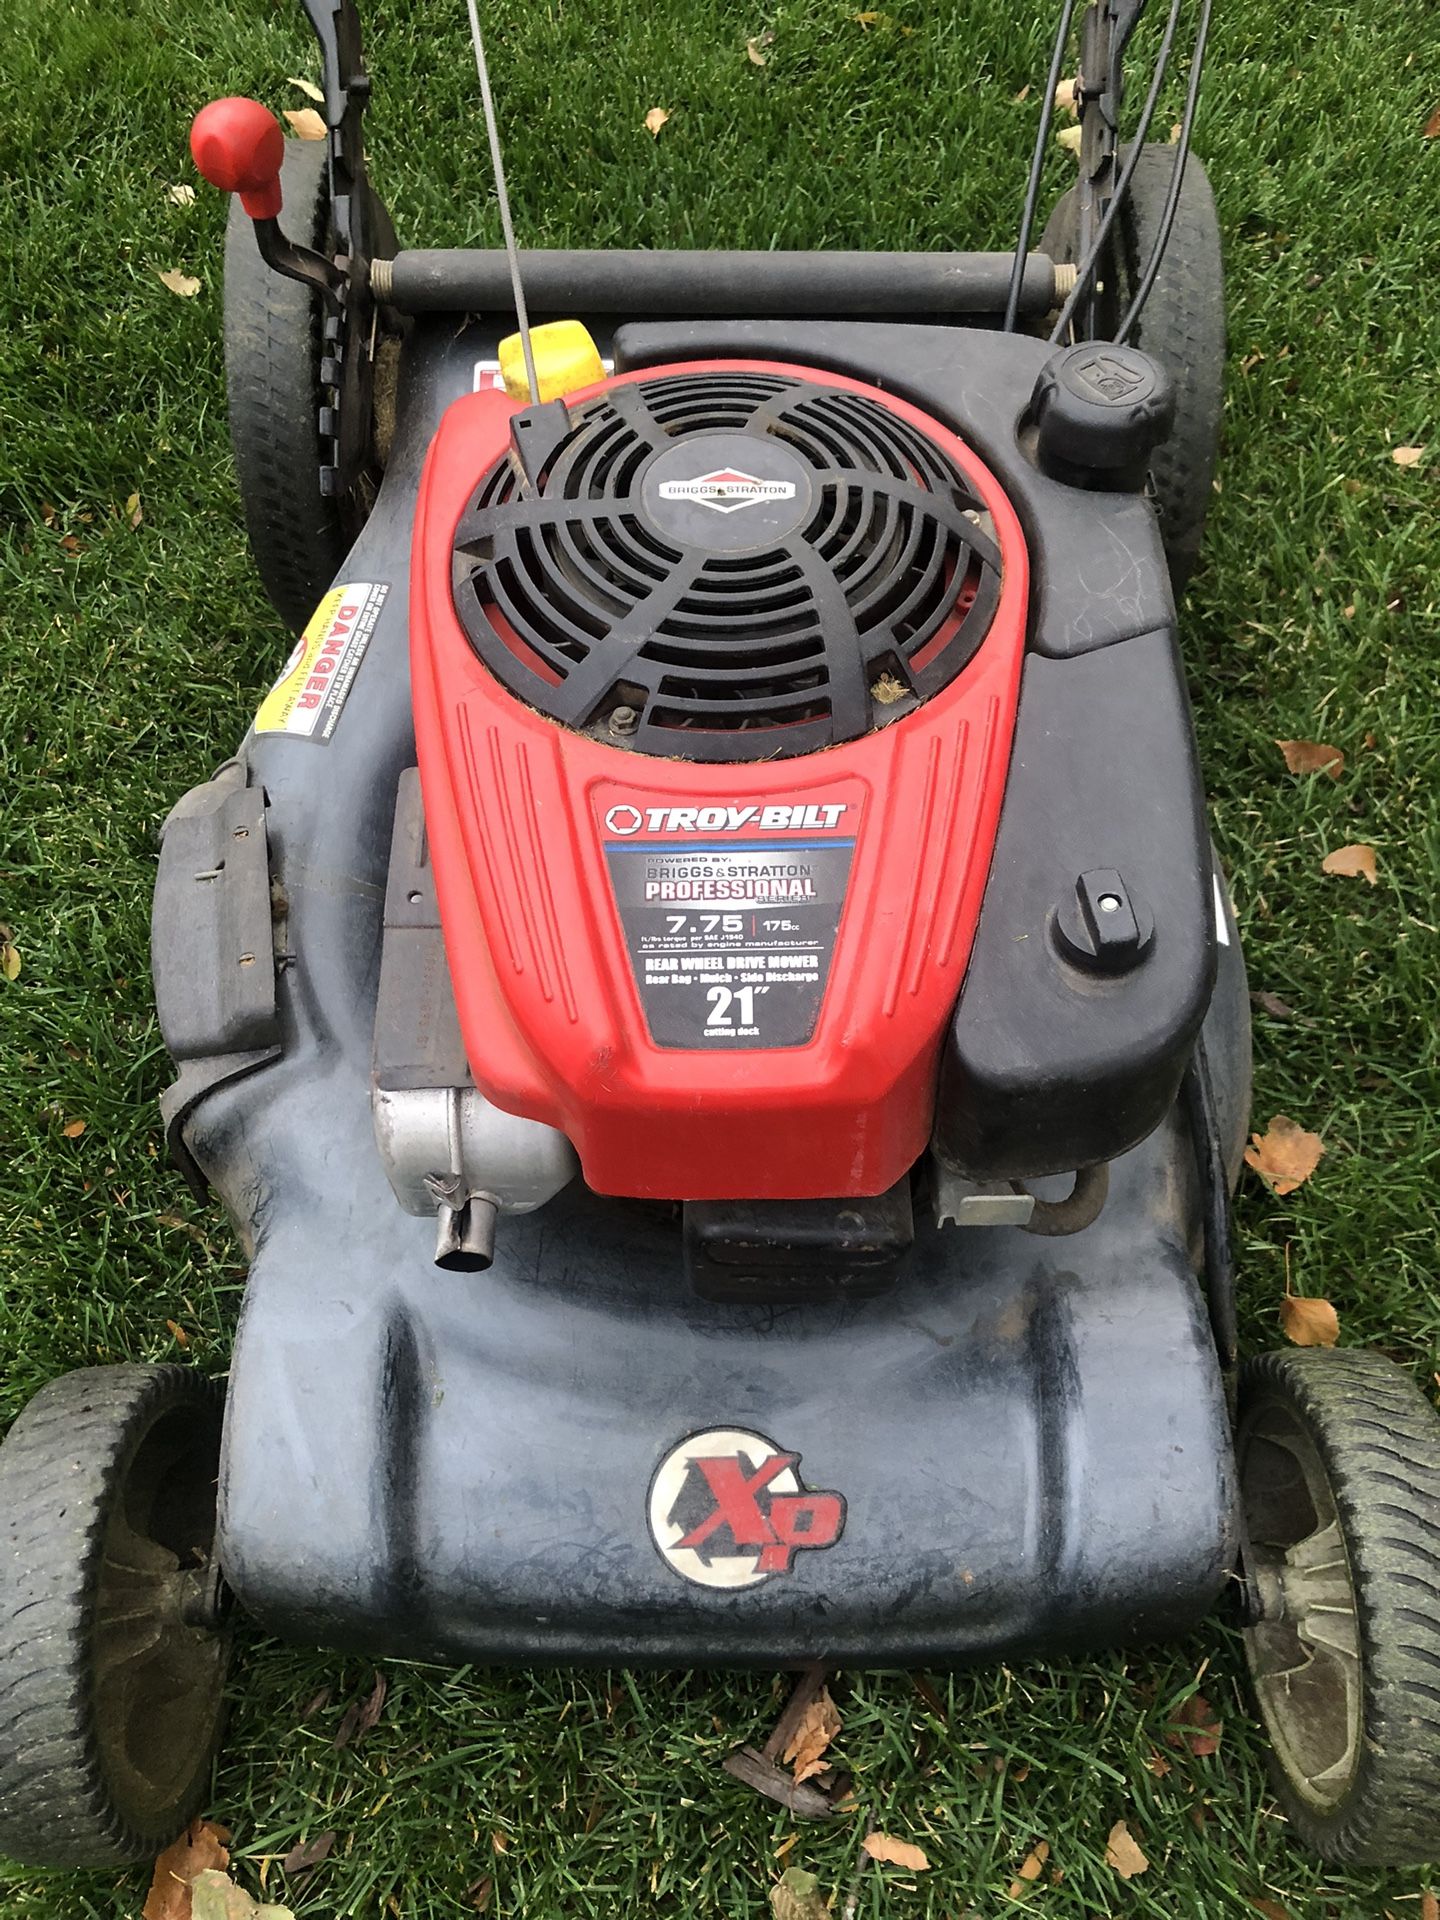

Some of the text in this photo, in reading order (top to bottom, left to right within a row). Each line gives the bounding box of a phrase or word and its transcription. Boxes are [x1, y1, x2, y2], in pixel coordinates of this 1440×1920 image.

[668, 485, 716, 494] BRIGGS
[726, 485, 787, 494] STRATTON
[374, 593, 385, 606] NOT
[363, 605, 380, 633] OPERATE
[354, 633, 369, 656] UNLESS
[296, 606, 359, 709] DANGER
[339, 648, 355, 674] CATCHER
[334, 666, 355, 704] UNDAMAGED
[645, 803, 847, 831] TROY-BILT
[647, 866, 713, 878] BRIGGS
[728, 864, 811, 877] STRATTON
[645, 878, 816, 900] PROFESSIONAL
[666, 915, 799, 933] 7.75 175cc
[657, 941, 687, 949] rated
[691, 941, 704, 949] by
[706, 941, 741, 949] engine
[645, 955, 818, 971] REAR WHEEL DRIVE MOWER
[645, 971, 818, 985] Rear Bag Mulch Side Discharge
[704, 1027, 760, 1037] cutting deck
